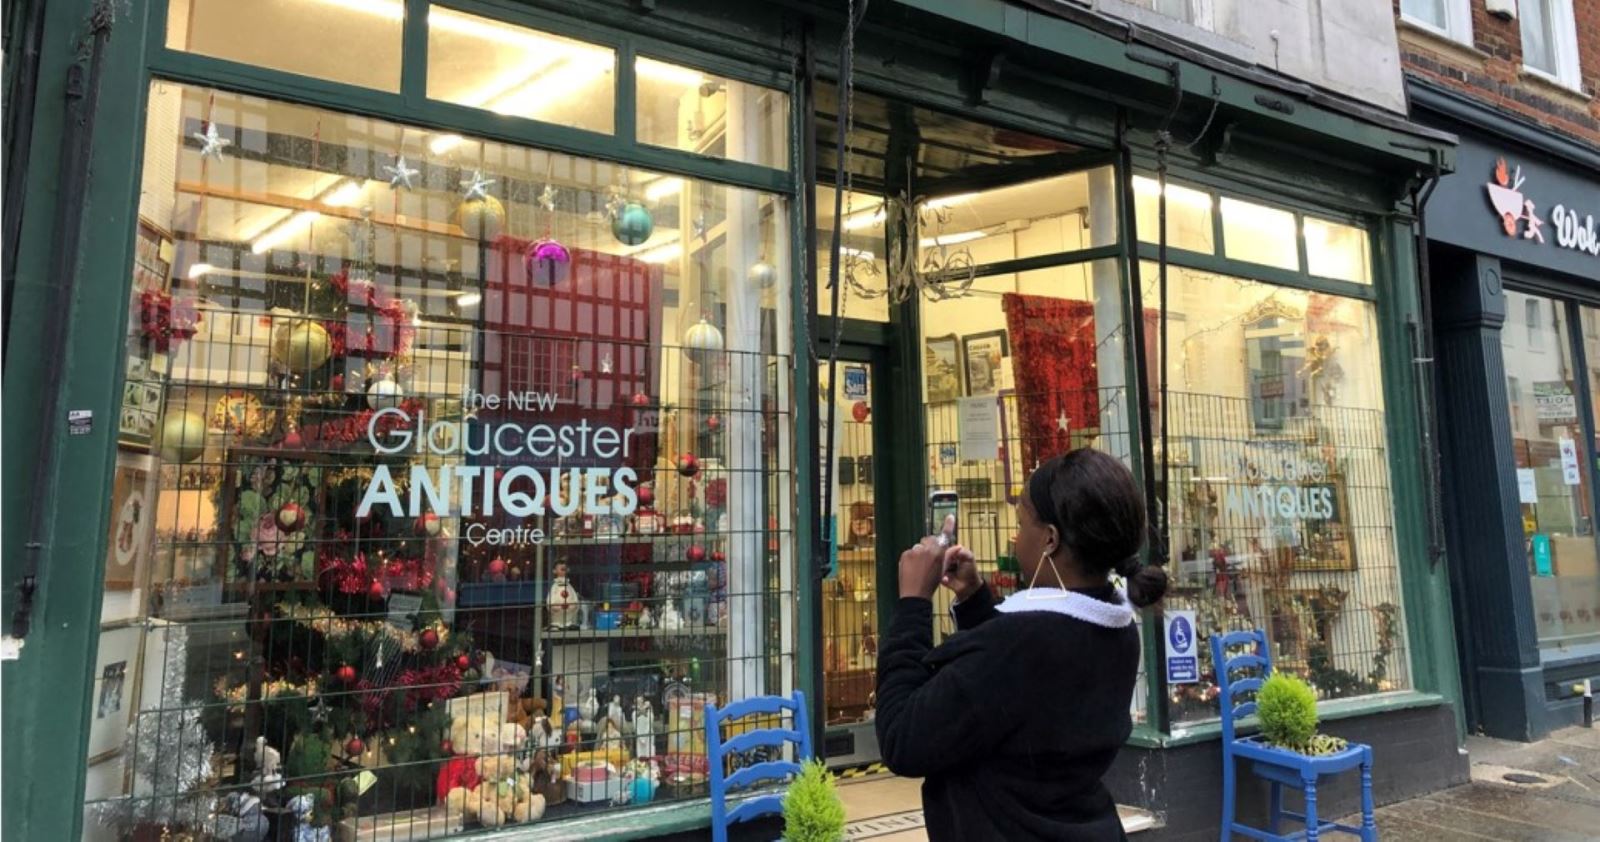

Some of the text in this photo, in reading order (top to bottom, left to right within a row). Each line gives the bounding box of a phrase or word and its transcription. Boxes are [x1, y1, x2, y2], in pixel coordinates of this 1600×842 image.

[463, 388, 558, 411] the NEW
[368, 407, 635, 458] Gloucester
[355, 464, 638, 518] ANTIQUES
[1227, 484, 1333, 519] ANTIQUES
[466, 523, 545, 545] Centre
